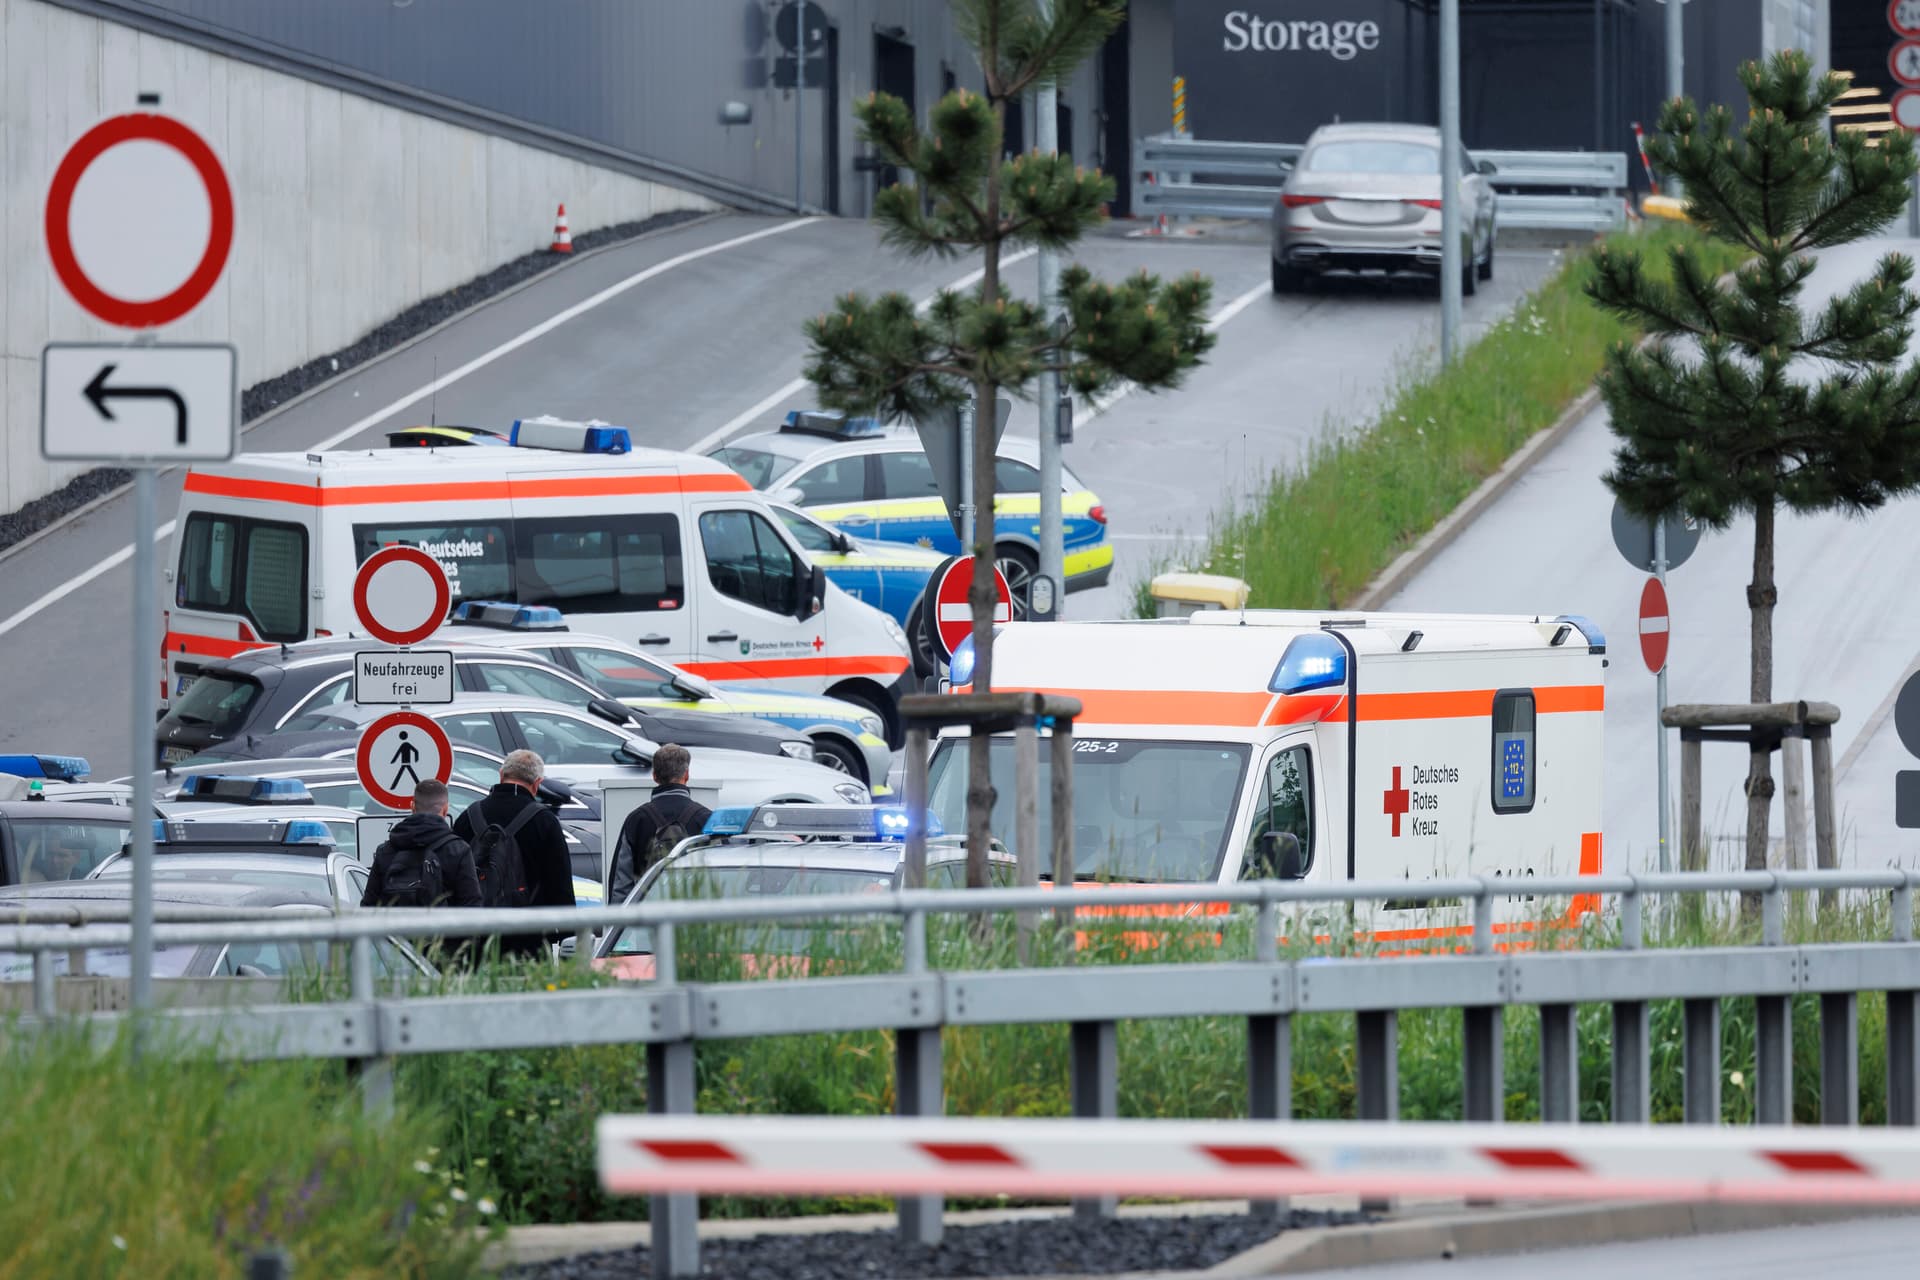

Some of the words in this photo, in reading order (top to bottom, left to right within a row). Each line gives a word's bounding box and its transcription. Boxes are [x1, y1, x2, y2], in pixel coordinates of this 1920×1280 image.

[1223, 10, 1380, 61] Storage
[419, 538, 484, 557] Deutsches
[440, 559, 459, 577] tes
[363, 661, 445, 680] Neufahrzeuge
[392, 682, 417, 696] frei
[1071, 740, 1120, 753] /25-2
[1412, 763, 1459, 785] Deutsches
[1509, 761, 1520, 776] 112
[1412, 790, 1439, 811] Rotes
[1412, 816, 1439, 837] Kreuz
